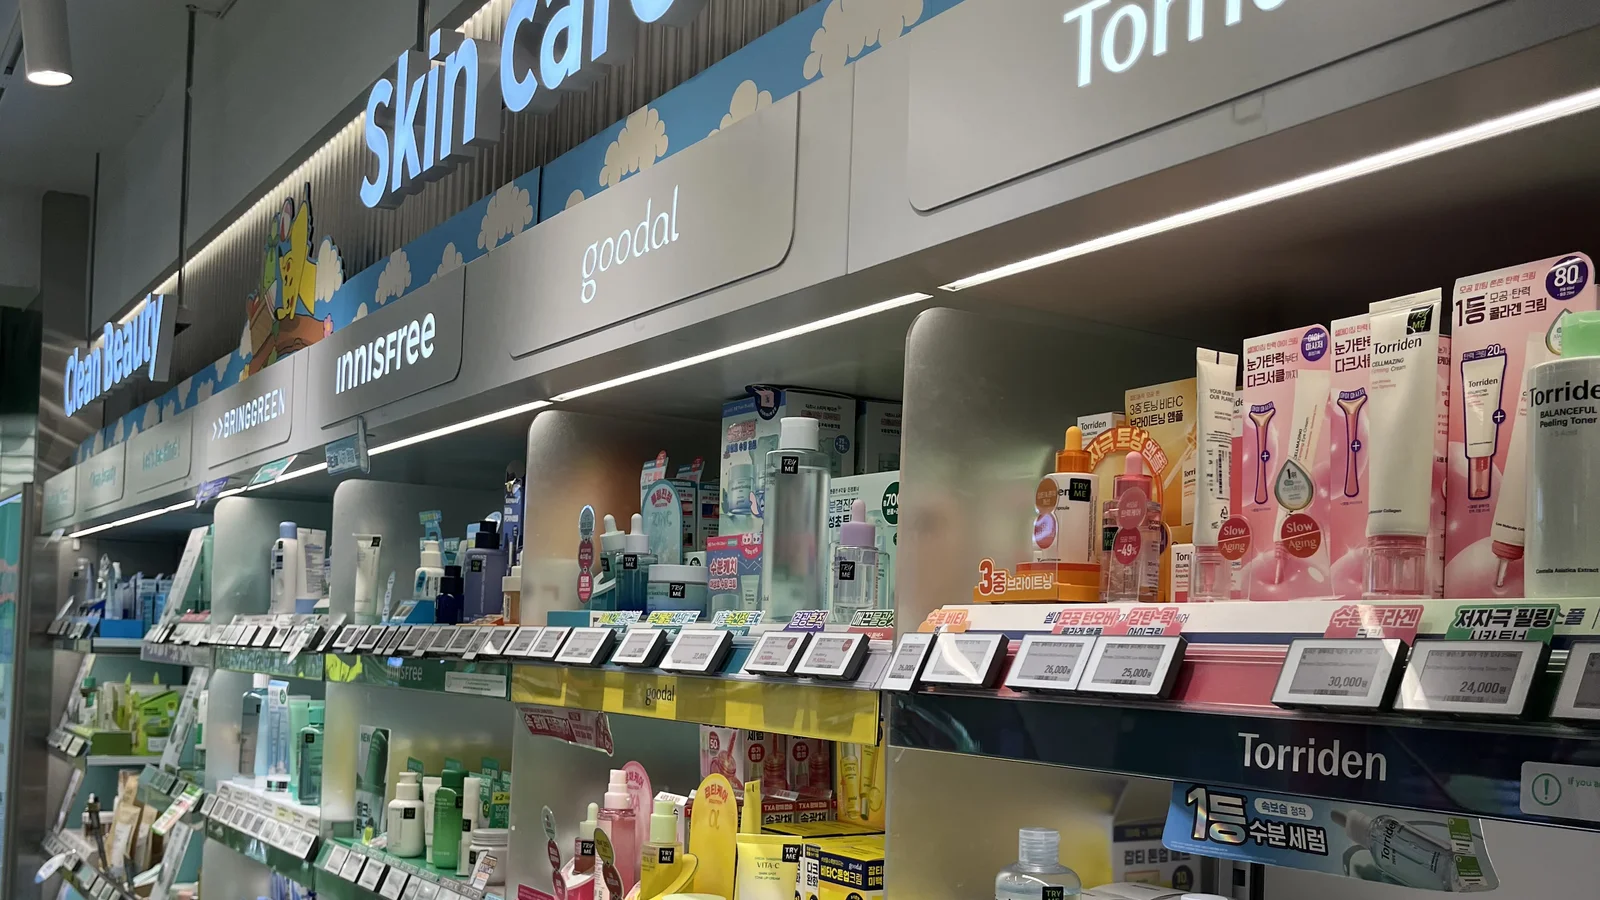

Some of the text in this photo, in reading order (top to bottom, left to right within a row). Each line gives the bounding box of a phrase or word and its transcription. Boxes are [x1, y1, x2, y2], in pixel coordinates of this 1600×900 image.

[360, 29, 478, 208] Skin
[580, 185, 680, 304] goodal
[1489, 297, 1547, 321] 콜라겐 크림
[1373, 337, 1422, 355] Torriden
[64, 293, 165, 417] Clean Beauty
[1372, 358, 1404, 368] CELLMAZING
[1468, 378, 1498, 388] Torriden
[223, 387, 286, 438] BRINGGREEN
[1130, 410, 1184, 428] 브라이트닝 앰플
[1540, 406, 1598, 419] BALANCEFUL
[1081, 420, 1107, 431] Torriden
[1540, 416, 1598, 429] Peeling Toner
[784, 458, 798, 467] TRY
[1073, 481, 1089, 490] TRY
[1073, 490, 1086, 498] ME
[1223, 526, 1247, 536] Slow
[1286, 519, 1313, 533] Slow
[1220, 541, 1246, 552] Aging
[1288, 536, 1317, 550] Aging
[842, 571, 852, 579] ME
[979, 559, 1054, 596] 3중 브라이트닝
[1059, 611, 1082, 625] 모공
[1455, 607, 1513, 629] 저자극
[1513, 608, 1555, 628] 필링
[645, 684, 675, 707] goodal
[1237, 732, 1387, 782] Torriden
[1575, 779, 1592, 788] you
[1185, 787, 1248, 845] 1등
[1261, 800, 1307, 818] 속보습 정착
[1249, 820, 1286, 847] 수분
[1288, 825, 1328, 854] 세럼
[1380, 820, 1398, 860] Torriden
[1045, 890, 1061, 898] TRY
